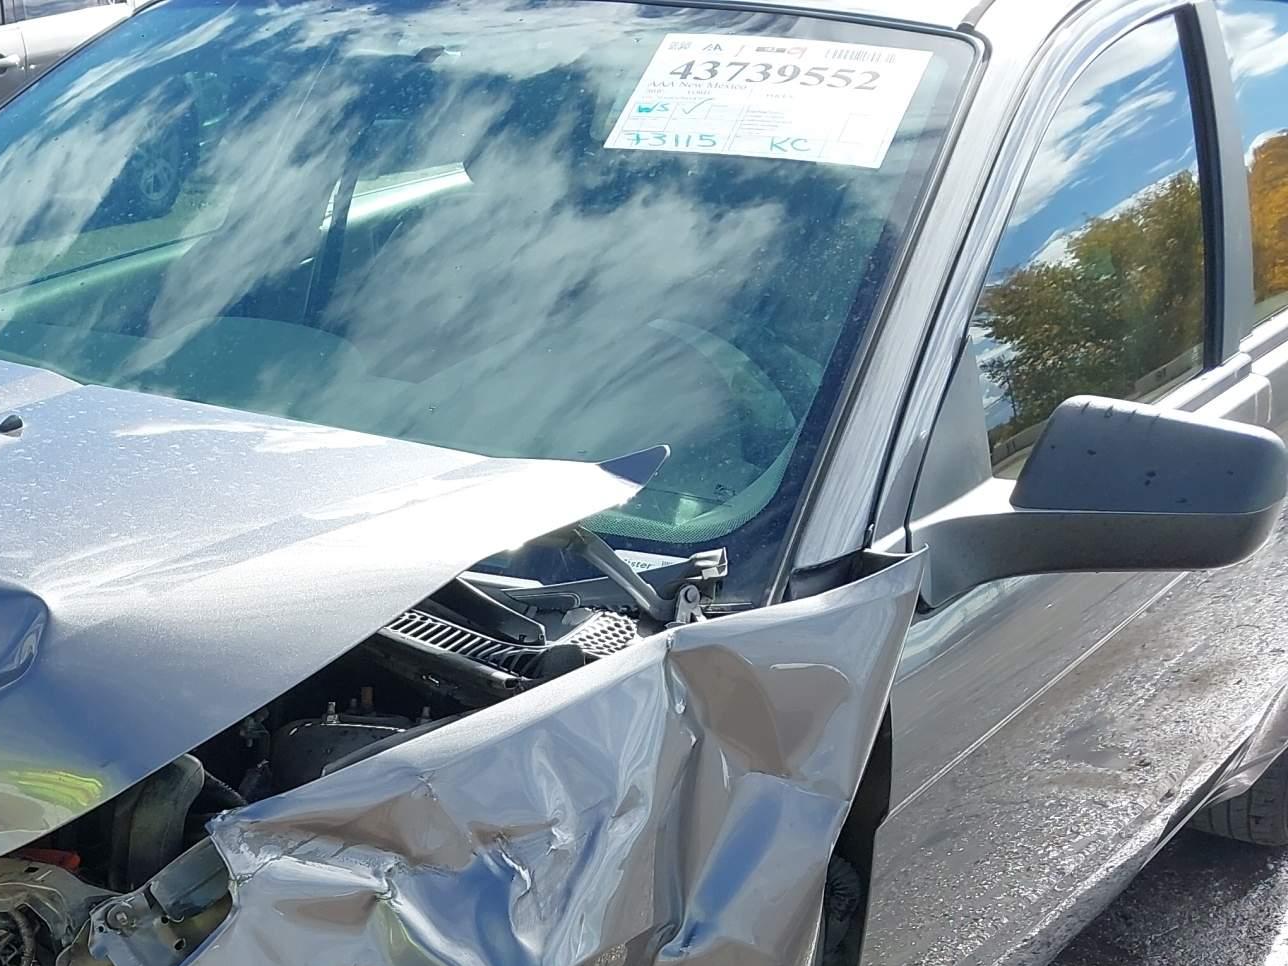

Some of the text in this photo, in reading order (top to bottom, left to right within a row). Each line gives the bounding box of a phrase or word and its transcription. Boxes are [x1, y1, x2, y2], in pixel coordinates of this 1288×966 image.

[669, 59, 881, 91] 43739552
[706, 81, 748, 90] Mexico
[769, 136, 812, 152] KC
